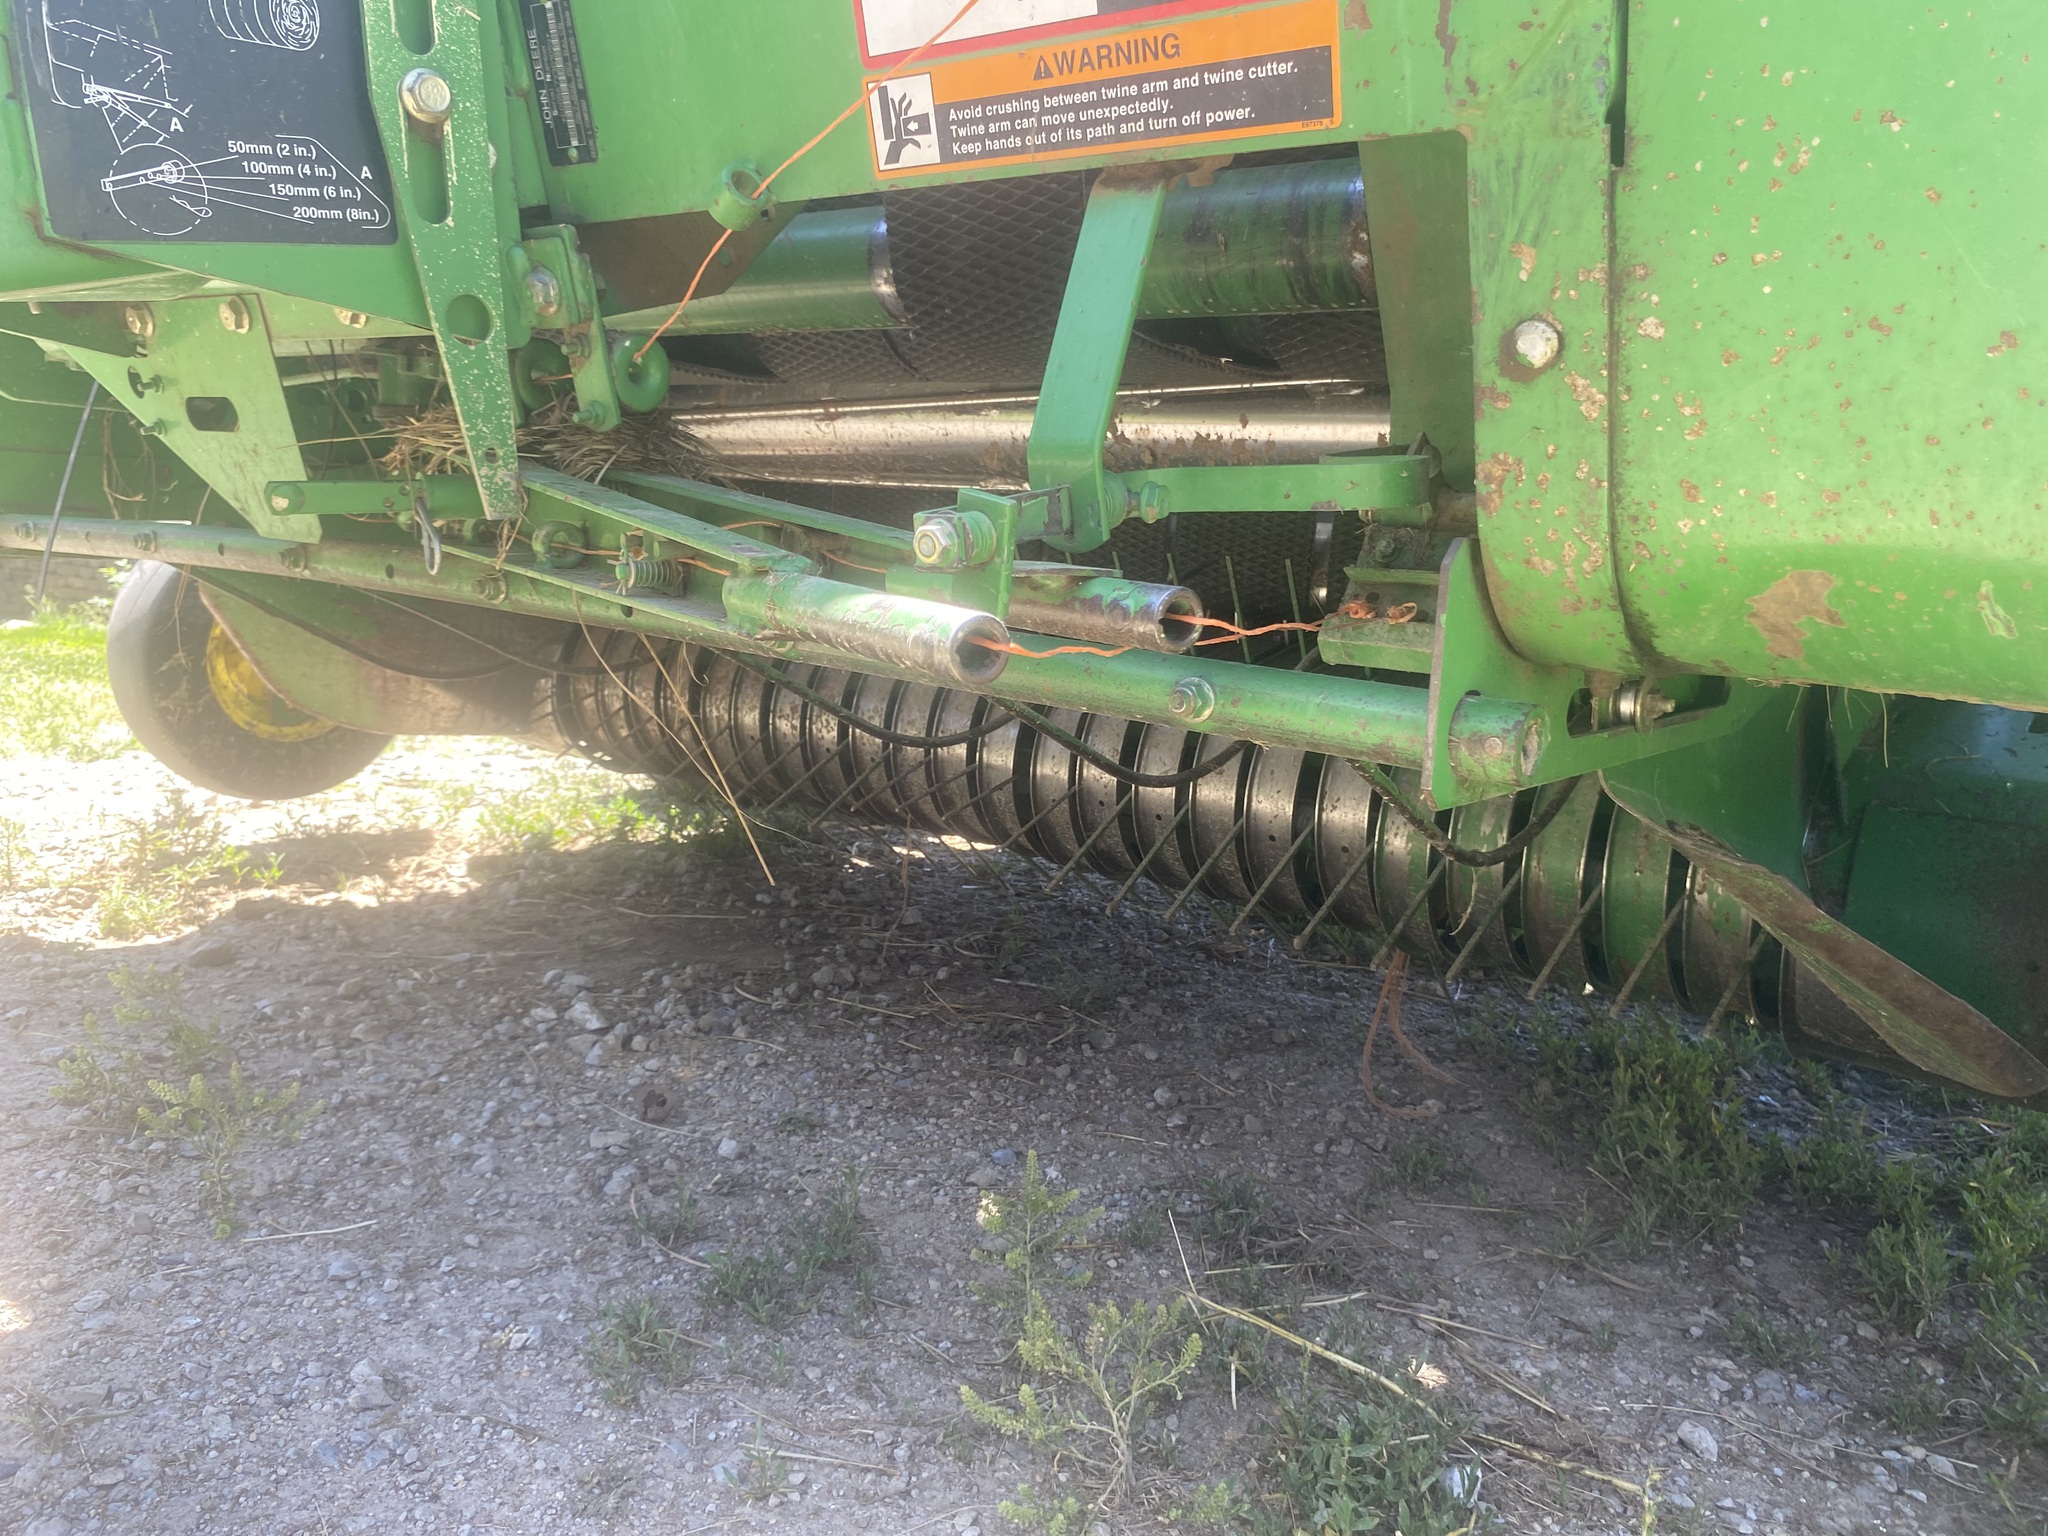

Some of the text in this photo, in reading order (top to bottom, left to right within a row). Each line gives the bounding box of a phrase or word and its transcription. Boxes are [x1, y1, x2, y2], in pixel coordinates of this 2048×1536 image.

[1053, 33, 1180, 76] WARNING
[527, 29, 554, 129] JOHN DEERE
[949, 60, 1298, 121] Avoid crushing between twine arm and twine cutter.
[170, 116, 184, 132] A
[950, 97, 1174, 138] Twine arm can move unexpectedly.
[952, 106, 1256, 155] Keep hands out of its path and turn off power.
[227, 140, 317, 160] 50mm (2 in.)
[241, 160, 337, 180] 100mm (4 in.)
[360, 165, 373, 180] A
[269, 183, 361, 201] 150mm (6 in.)
[292, 206, 380, 223] 200mm (8in.)
